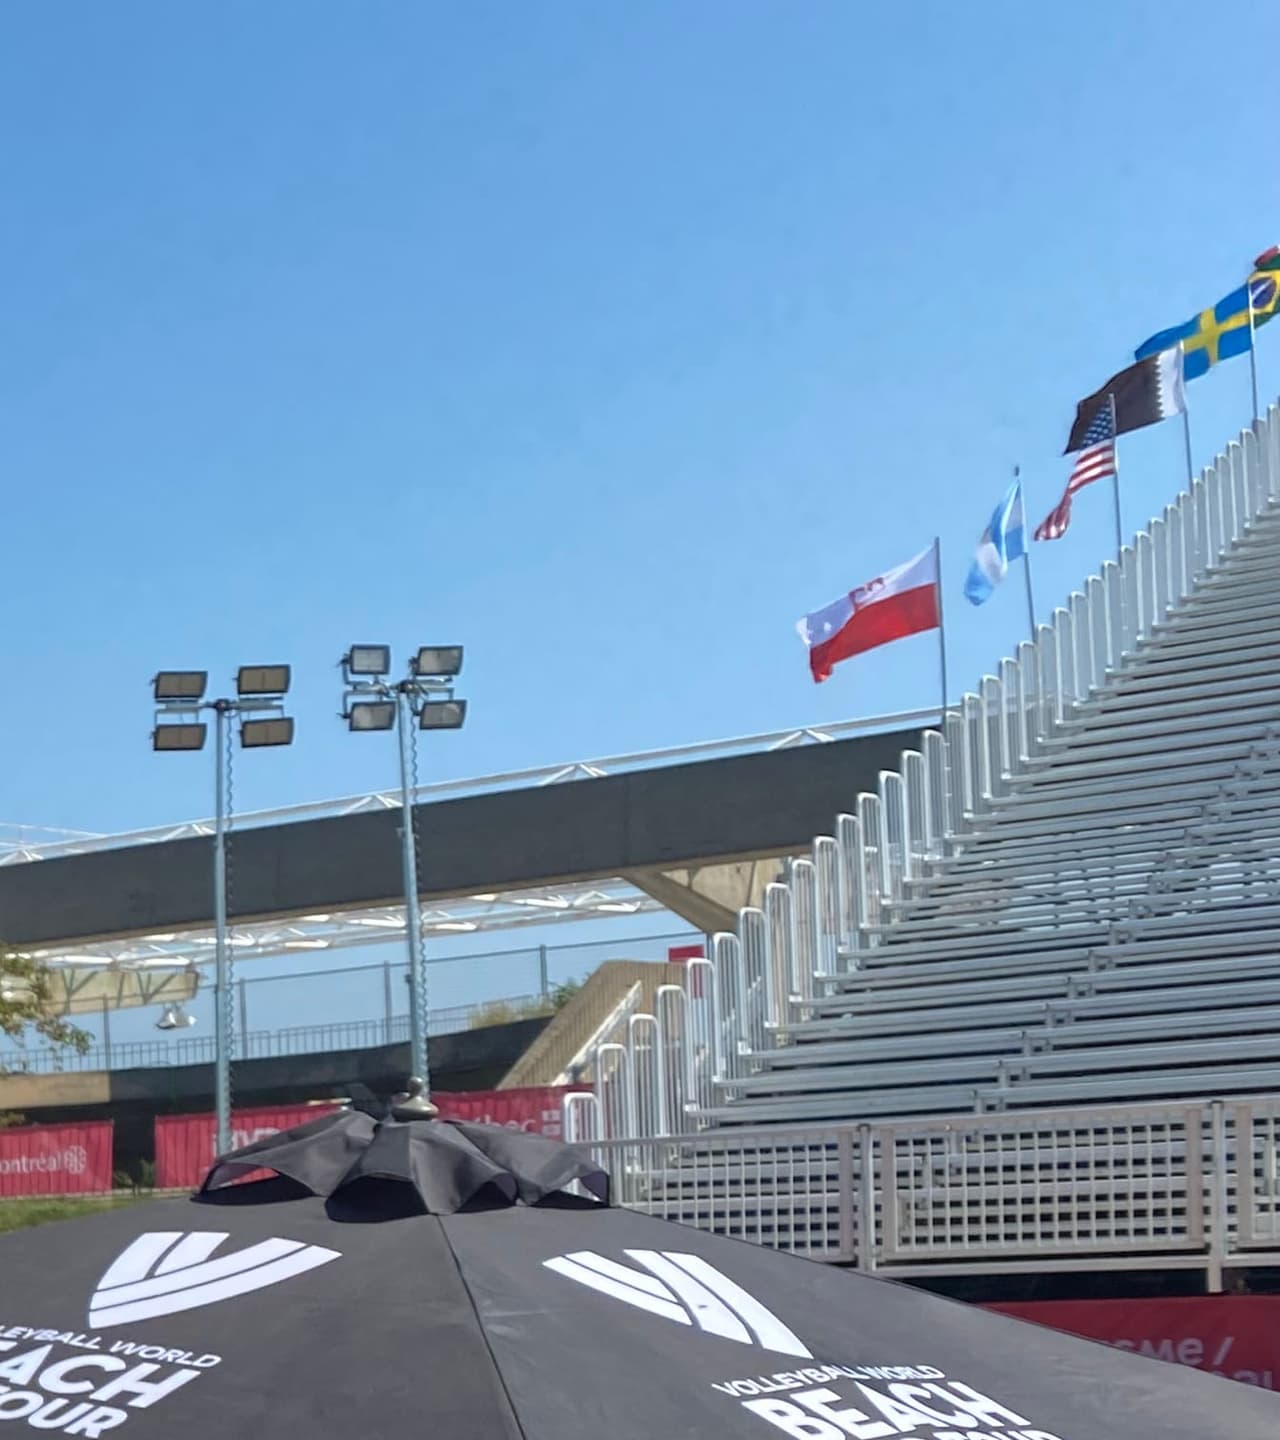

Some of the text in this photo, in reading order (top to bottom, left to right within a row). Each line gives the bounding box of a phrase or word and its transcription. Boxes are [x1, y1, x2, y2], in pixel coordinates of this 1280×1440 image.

[110, 1340, 222, 1368] WORLD
[711, 1365, 946, 1397] VOLLEYBALL WORLD
